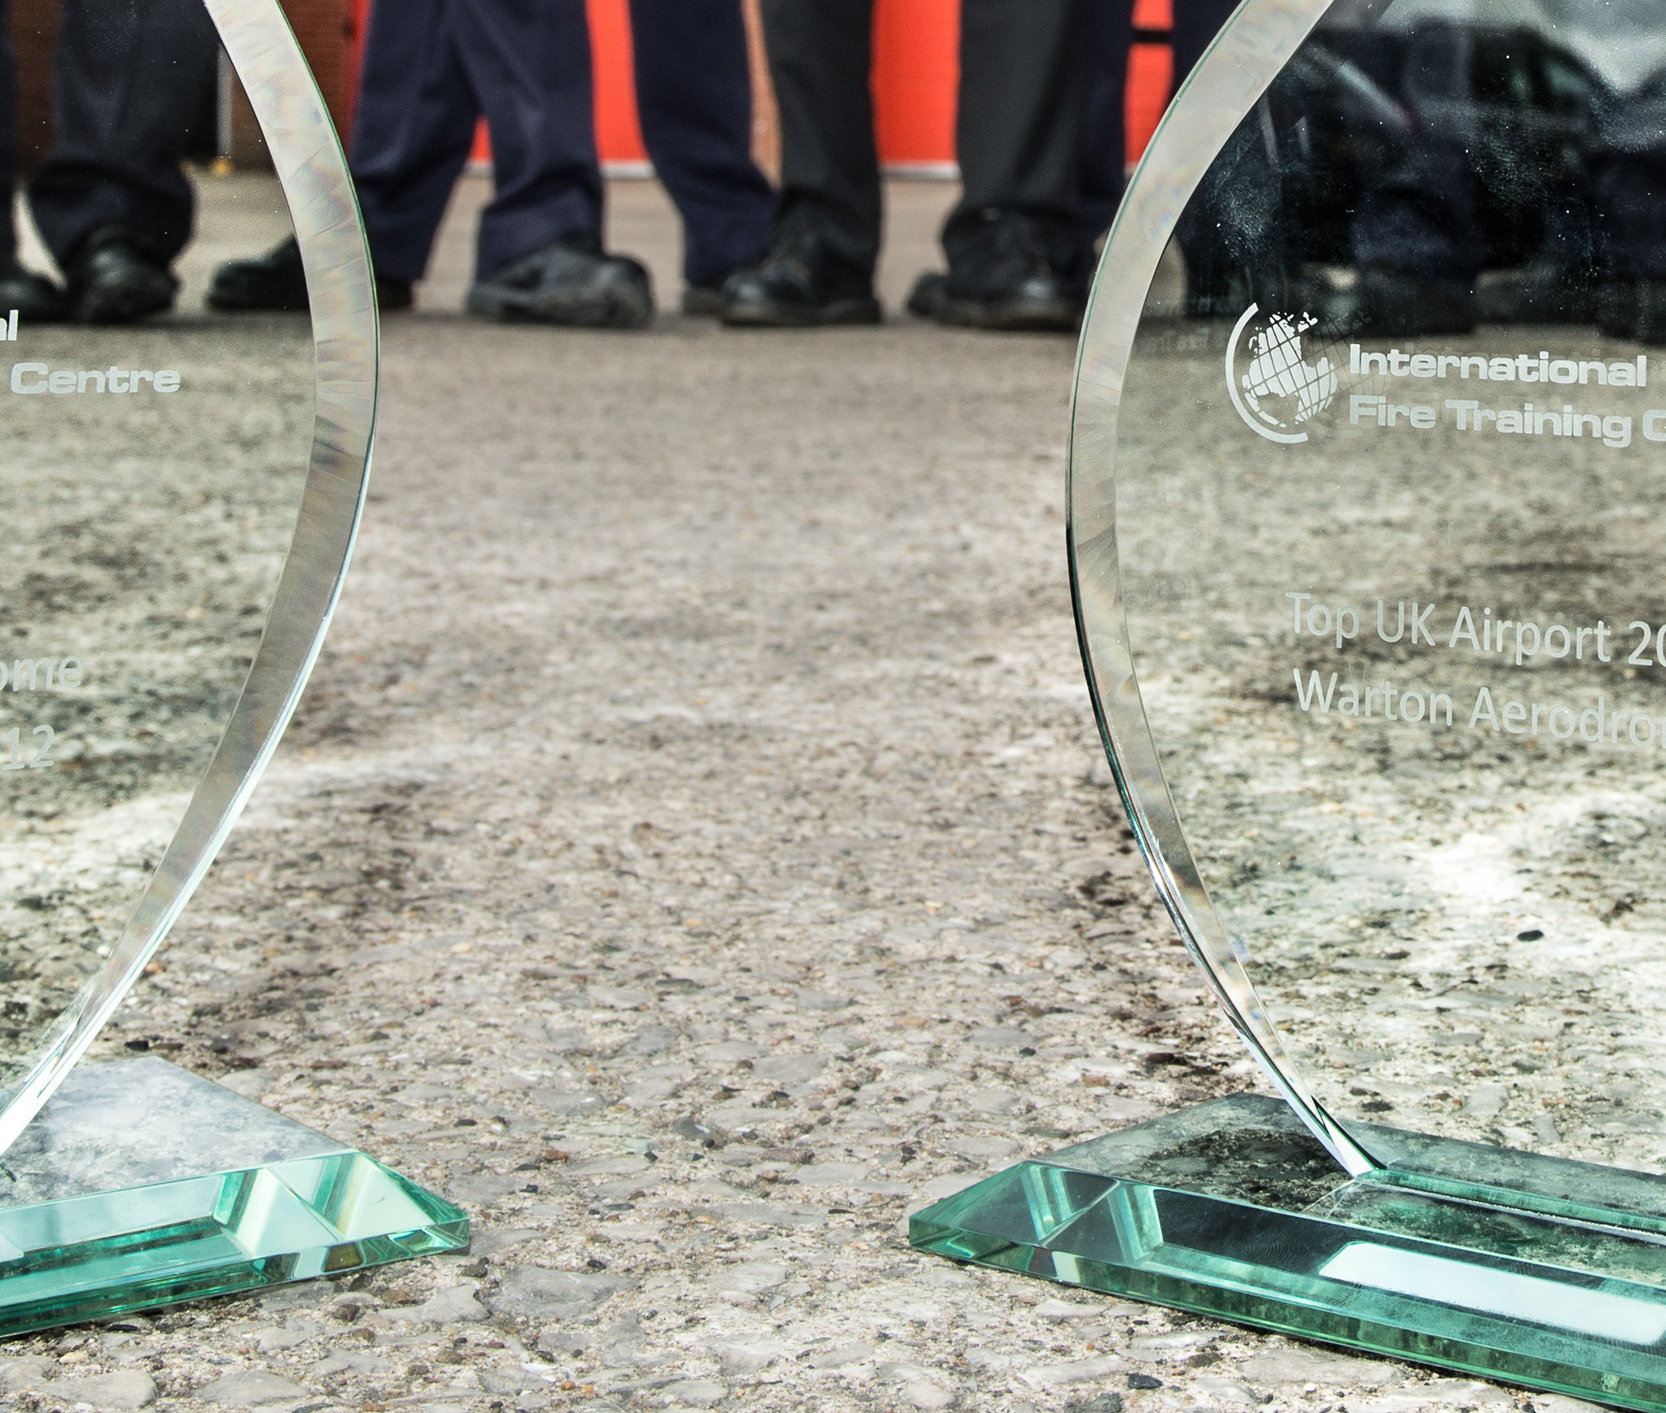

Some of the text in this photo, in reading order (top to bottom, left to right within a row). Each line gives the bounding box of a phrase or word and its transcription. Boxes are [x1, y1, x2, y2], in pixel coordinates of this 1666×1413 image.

[11, 362, 181, 393] Centre
[1349, 343, 1647, 387] International
[1349, 394, 1436, 430] Fire
[1445, 399, 1631, 448] Training
[1285, 592, 1360, 649] Top
[1377, 599, 1436, 646] UK
[1449, 606, 1611, 665] Airport
[1293, 668, 1453, 726] Warton
